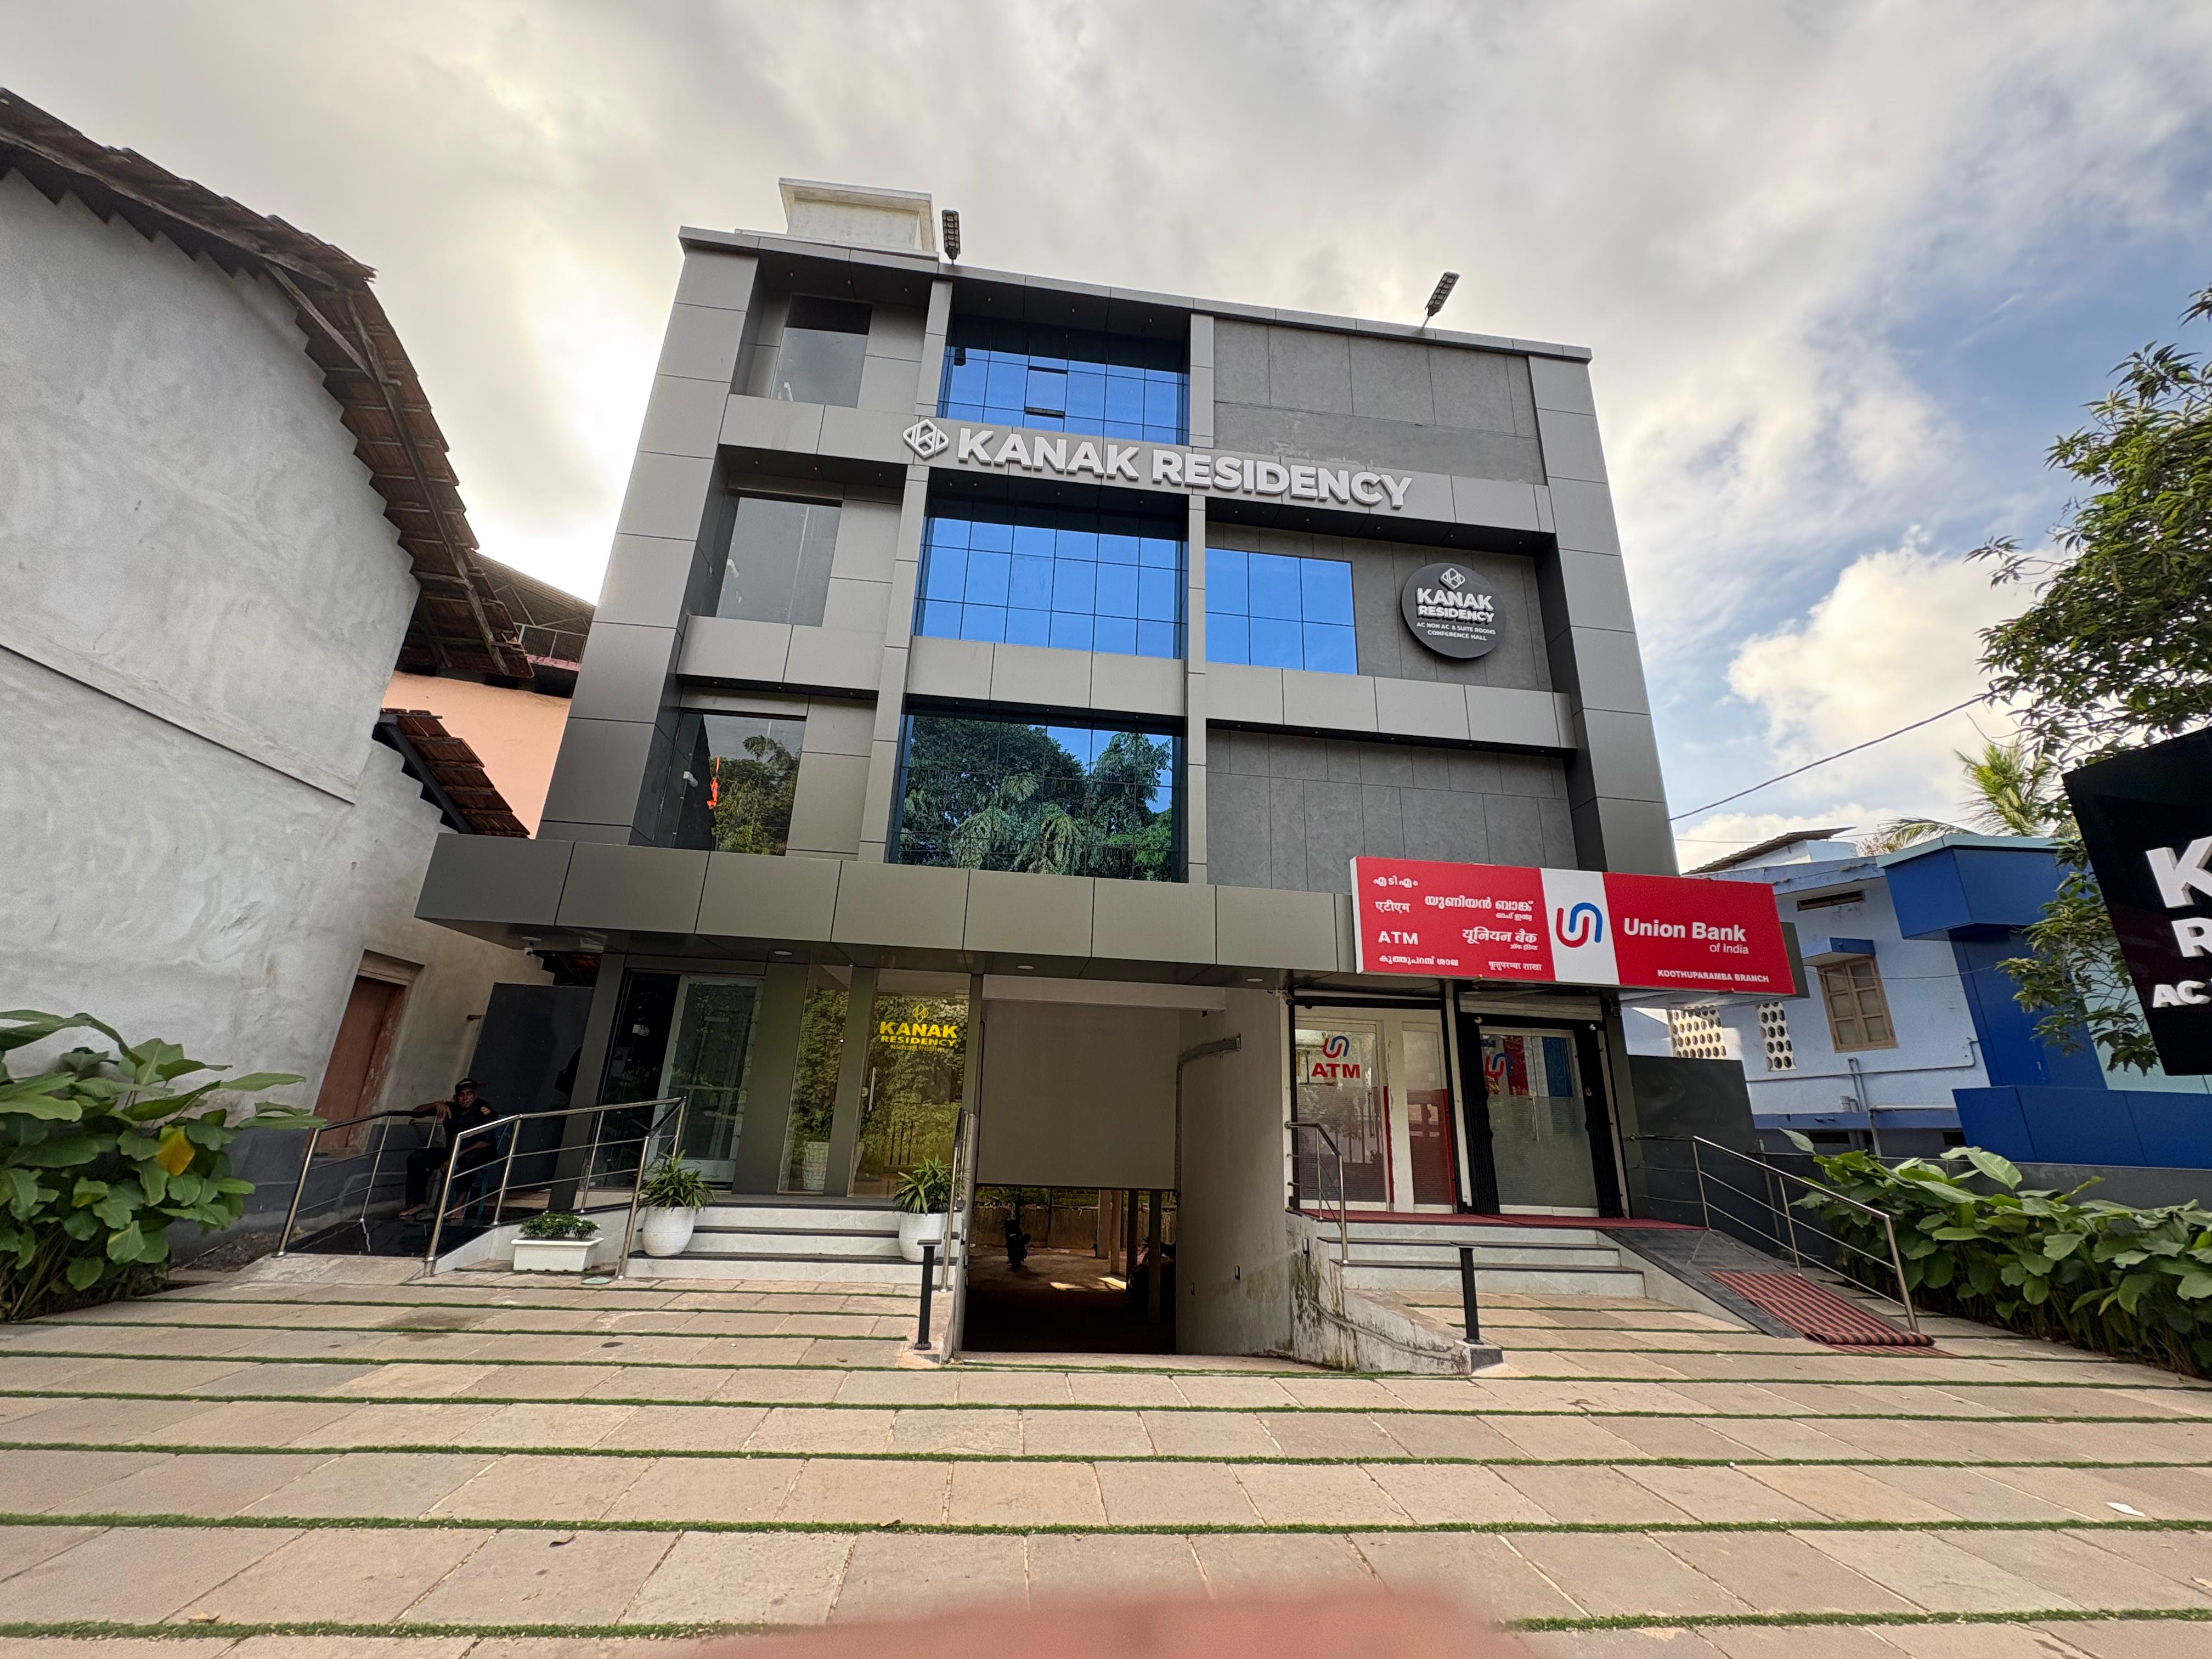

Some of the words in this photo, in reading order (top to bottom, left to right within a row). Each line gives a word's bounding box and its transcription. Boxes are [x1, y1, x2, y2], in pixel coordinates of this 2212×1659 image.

[958, 427, 1139, 481] KANAK
[1152, 449, 1413, 509] RESIDENCY
[1417, 588, 1494, 611] KANAK
[1417, 605, 1494, 623] RESIDENCY
[1427, 630, 1469, 639] CONFERENCE
[1375, 899, 1411, 914] एटीएम
[1378, 930, 1418, 945] ATM
[1462, 926, 1513, 944] यूनियन
[1624, 918, 1686, 938] Union
[1691, 922, 1746, 941] Bank
[1709, 943, 1720, 952] of
[1723, 943, 1749, 955] India
[1657, 969, 1733, 981] KOOTHUPARAMBA
[1735, 973, 1769, 983] BRANCH
[2152, 980, 2211, 1008] AC
[880, 1022, 958, 1038] KANAK
[881, 1036, 956, 1047] RESIDENCY
[1311, 1063, 1361, 1079] ATM
